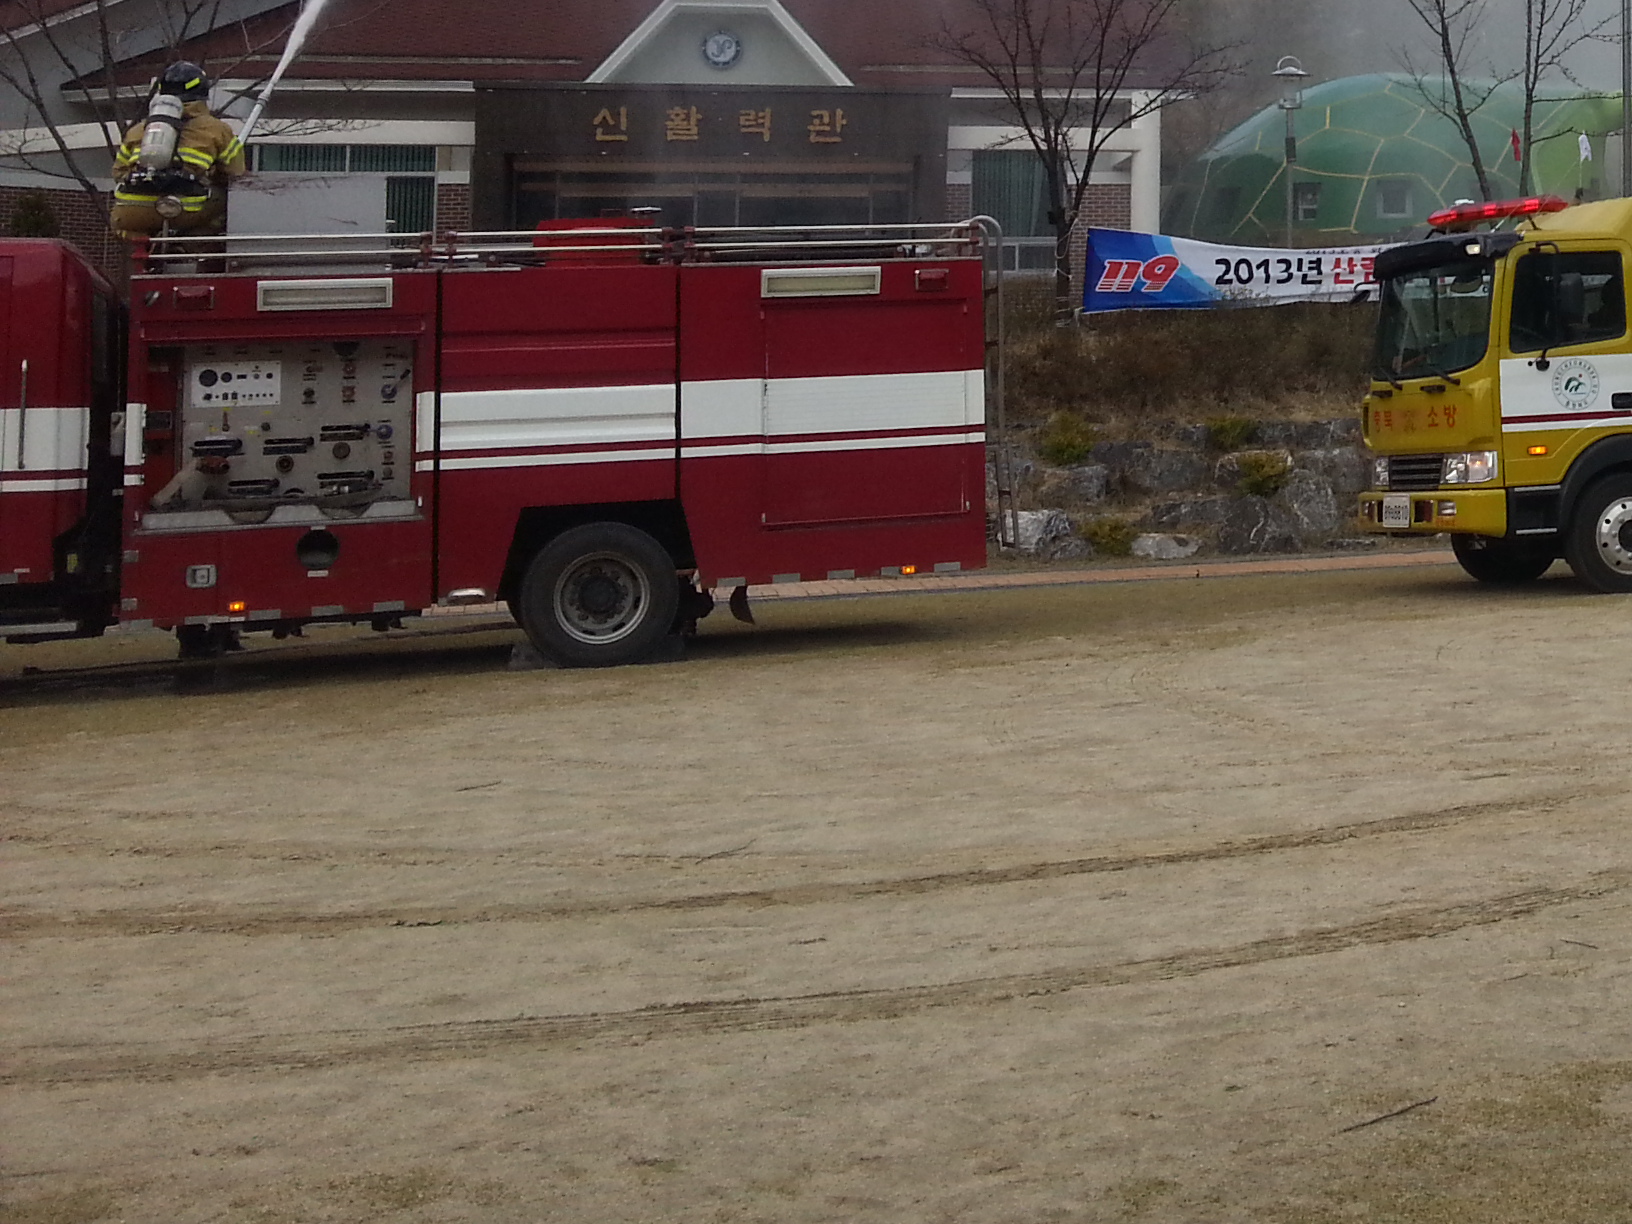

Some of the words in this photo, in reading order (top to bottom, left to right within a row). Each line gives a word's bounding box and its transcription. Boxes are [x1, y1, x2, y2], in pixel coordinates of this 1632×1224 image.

[592, 105, 847, 143] 신활력관
[1096, 255, 1179, 292] 119
[1214, 257, 1323, 286] 2013년
[1427, 405, 1457, 428] 소방
